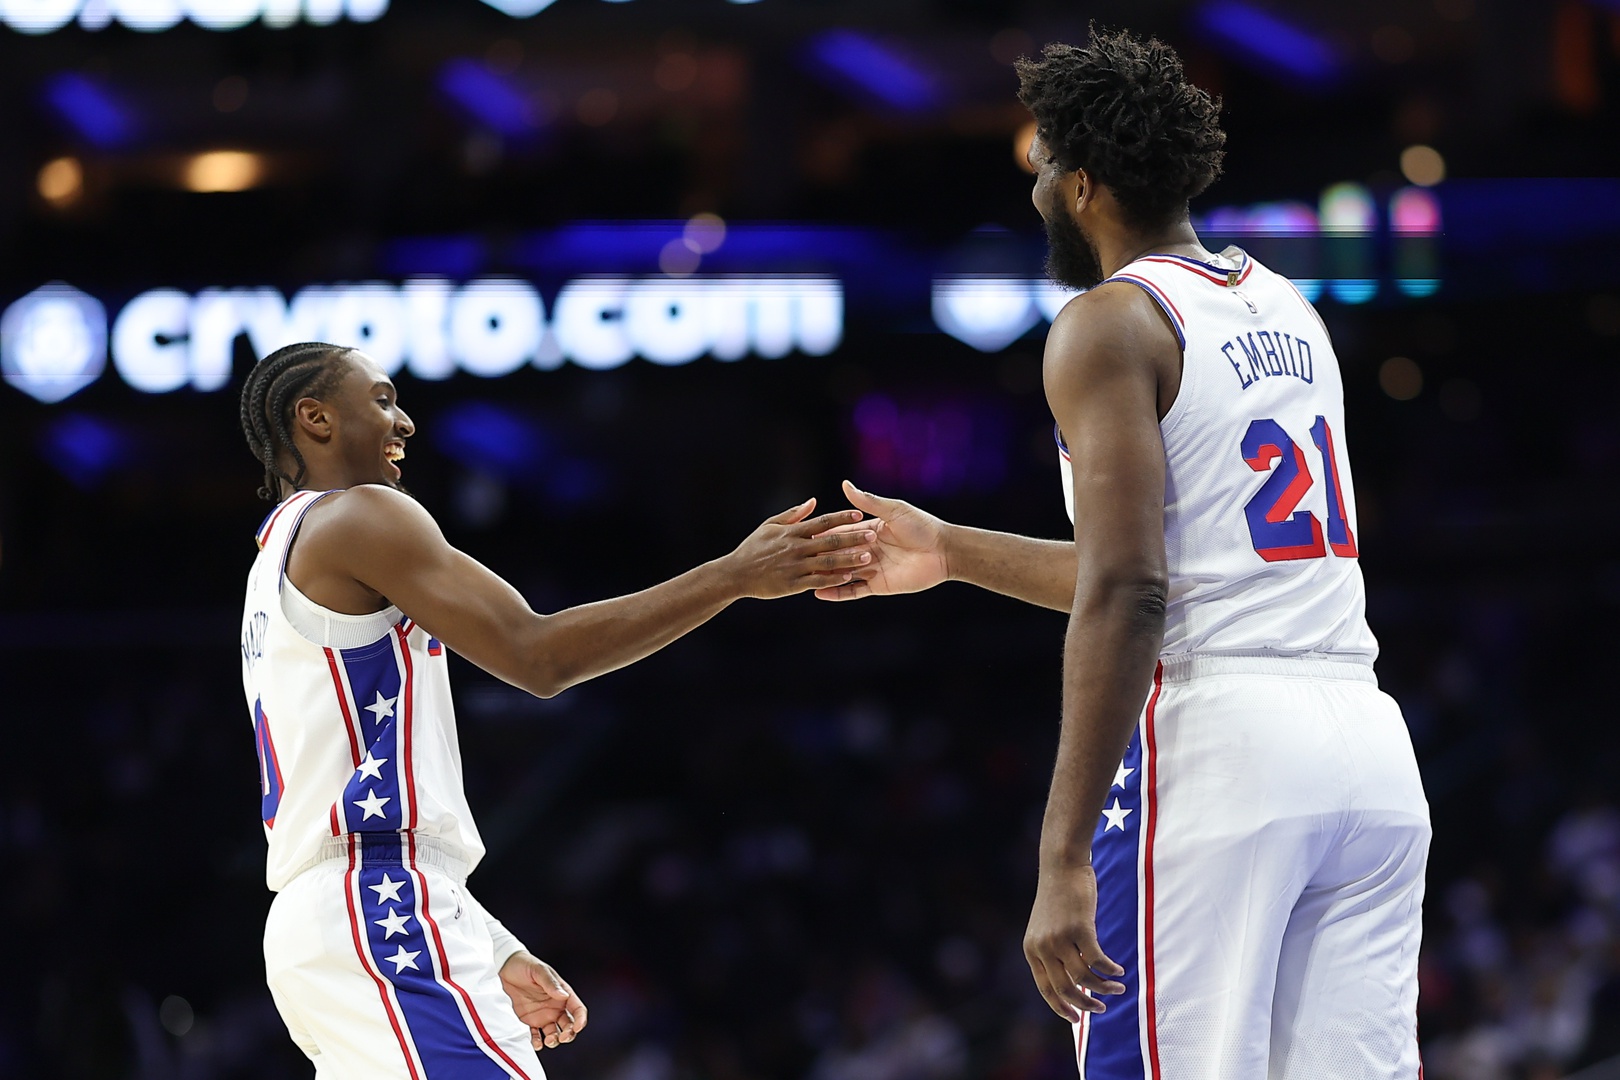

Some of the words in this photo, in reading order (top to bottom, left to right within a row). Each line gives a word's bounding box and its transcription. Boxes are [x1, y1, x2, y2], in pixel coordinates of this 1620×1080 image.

[111, 273, 845, 394] crypto.com
[1221, 330, 1314, 390] EMBIID
[1240, 415, 1359, 562] 21
